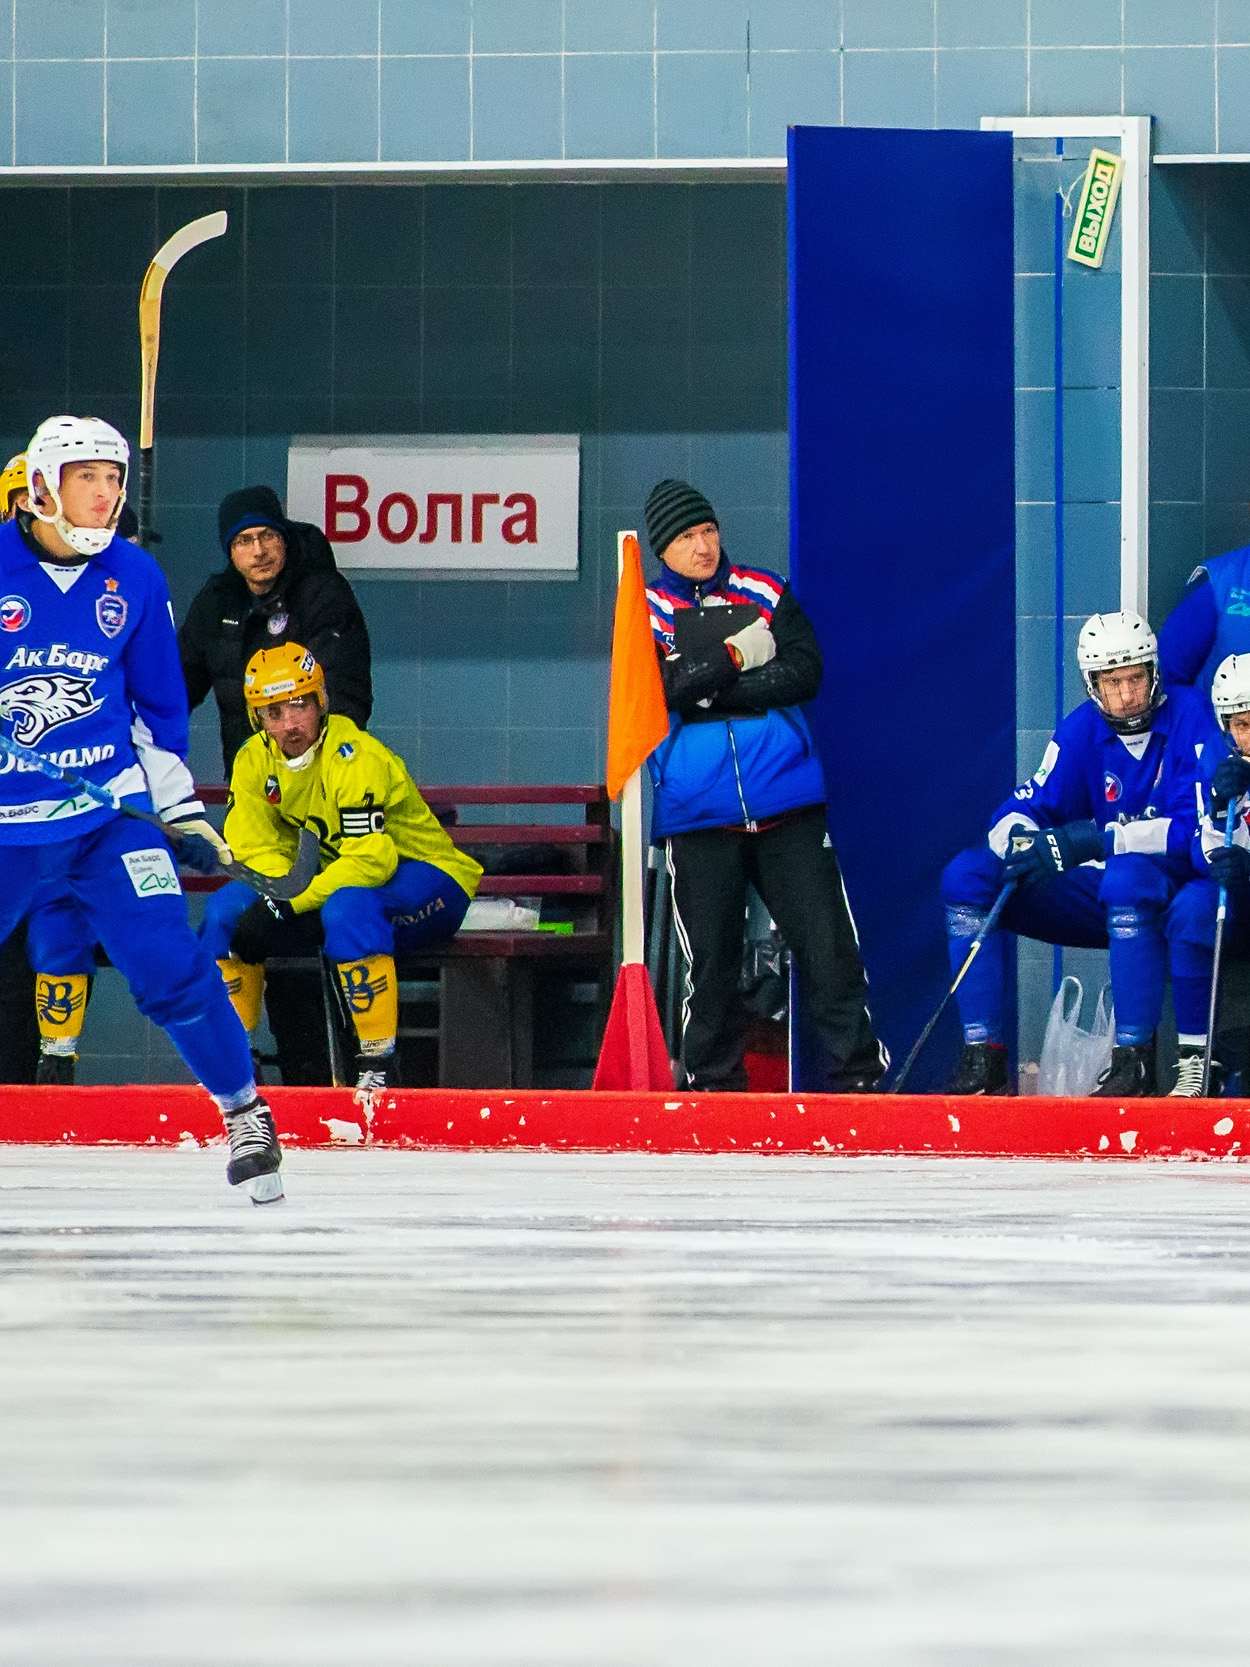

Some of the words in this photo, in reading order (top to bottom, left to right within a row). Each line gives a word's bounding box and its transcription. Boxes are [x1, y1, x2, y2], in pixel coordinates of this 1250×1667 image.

[1078, 163, 1115, 254] ВЫХОД
[325, 474, 538, 544] Волга
[5, 646, 45, 670] Ак
